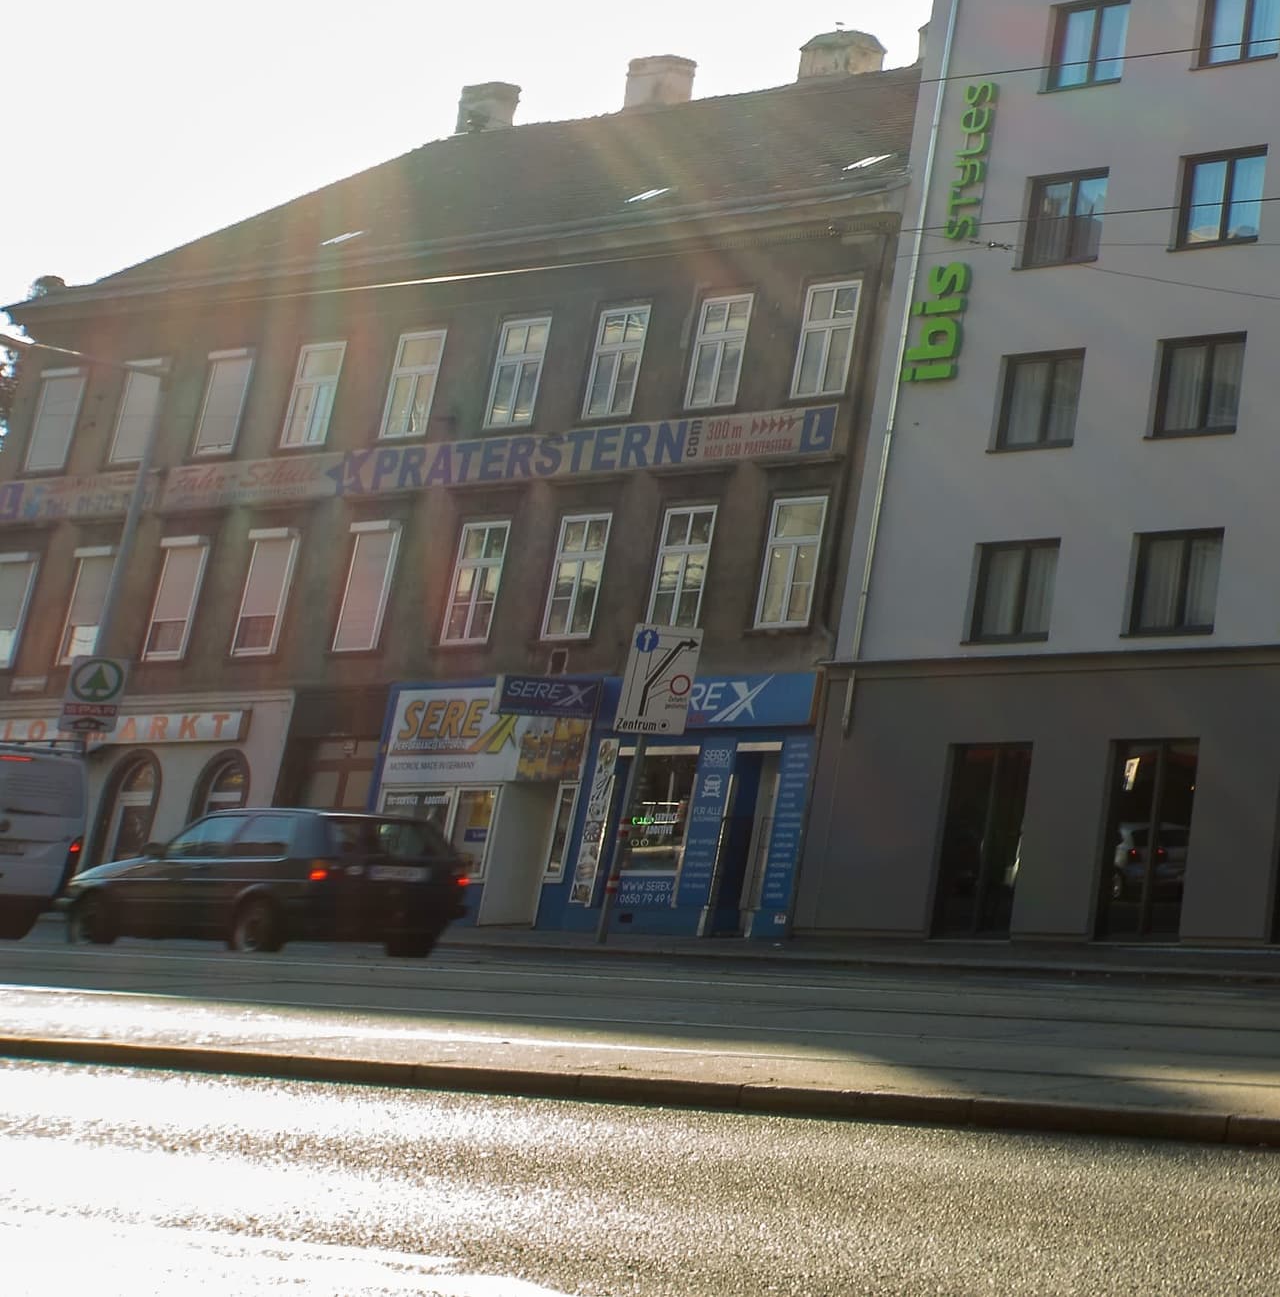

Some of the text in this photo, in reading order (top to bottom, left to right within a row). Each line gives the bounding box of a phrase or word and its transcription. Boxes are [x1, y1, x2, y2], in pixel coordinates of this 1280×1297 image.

[903, 260, 971, 382] ibis
[687, 420, 703, 458] com
[707, 420, 729, 441] 300
[811, 413, 825, 444] L
[371, 420, 688, 491] PRATERSTERN
[507, 680, 594, 706] SEREX
[616, 717, 657, 731] Zentrum
[619, 893, 640, 904] 0650
[641, 893, 653, 903] 79
